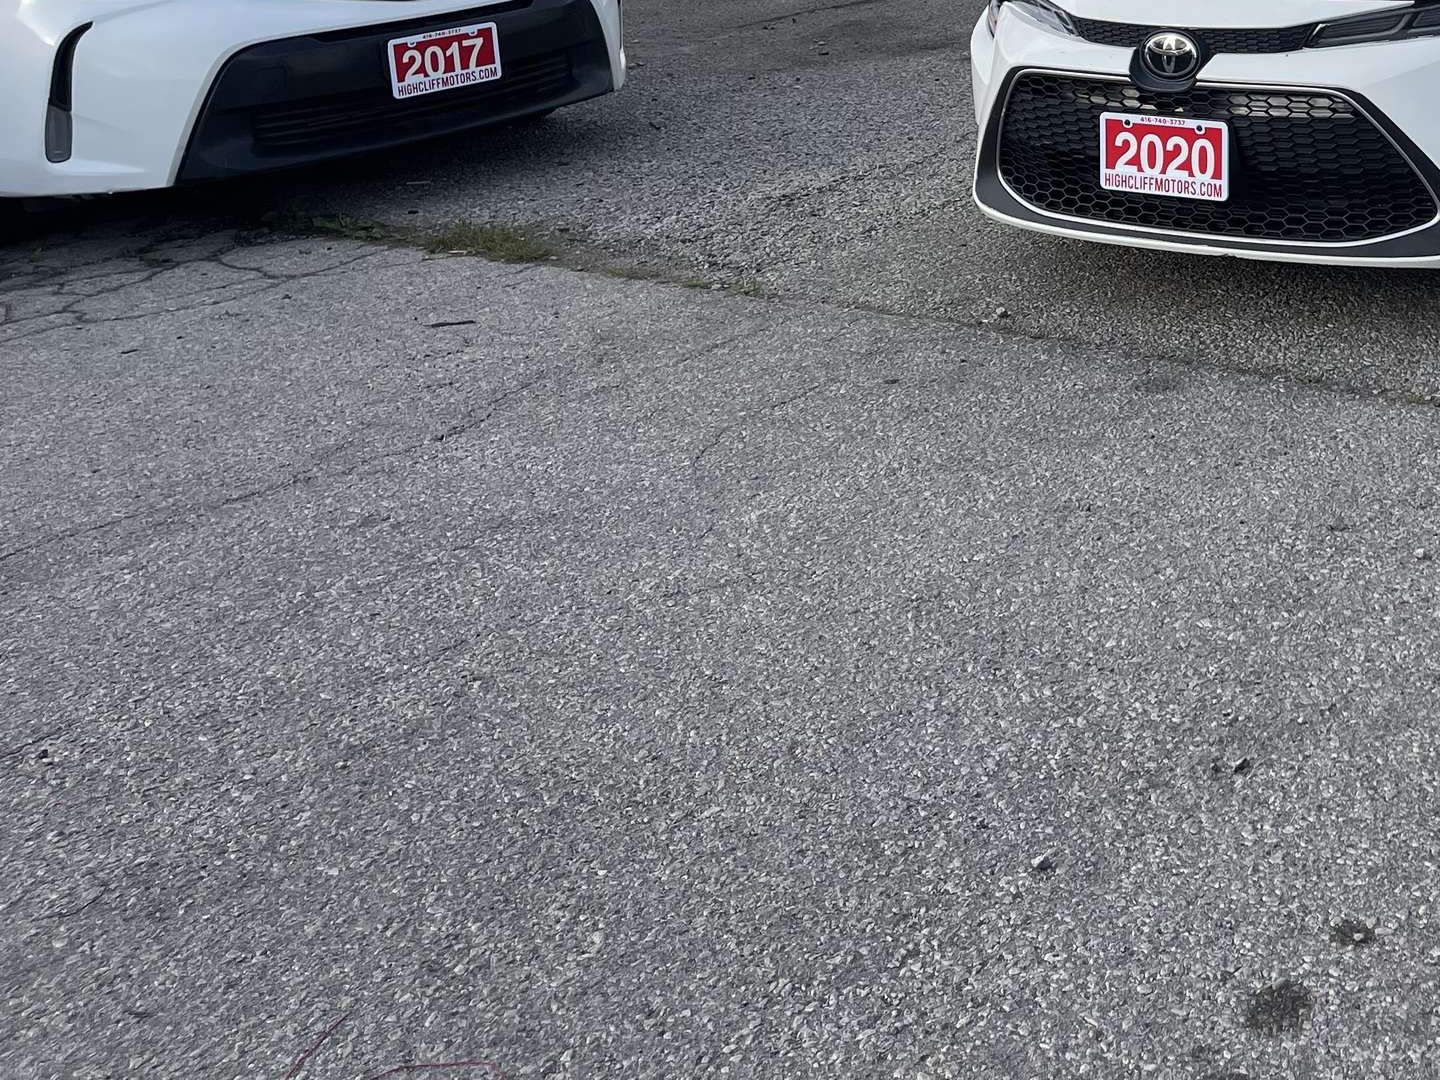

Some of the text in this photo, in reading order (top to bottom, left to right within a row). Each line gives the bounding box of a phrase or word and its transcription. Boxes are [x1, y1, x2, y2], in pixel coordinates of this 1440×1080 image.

[402, 37, 484, 82] 2017
[397, 67, 498, 97] HIGHCLIFFMOTORS.COM
[1114, 131, 1215, 180] 2020
[1104, 172, 1223, 198] HIGHCLIFFMOTORS.COM
